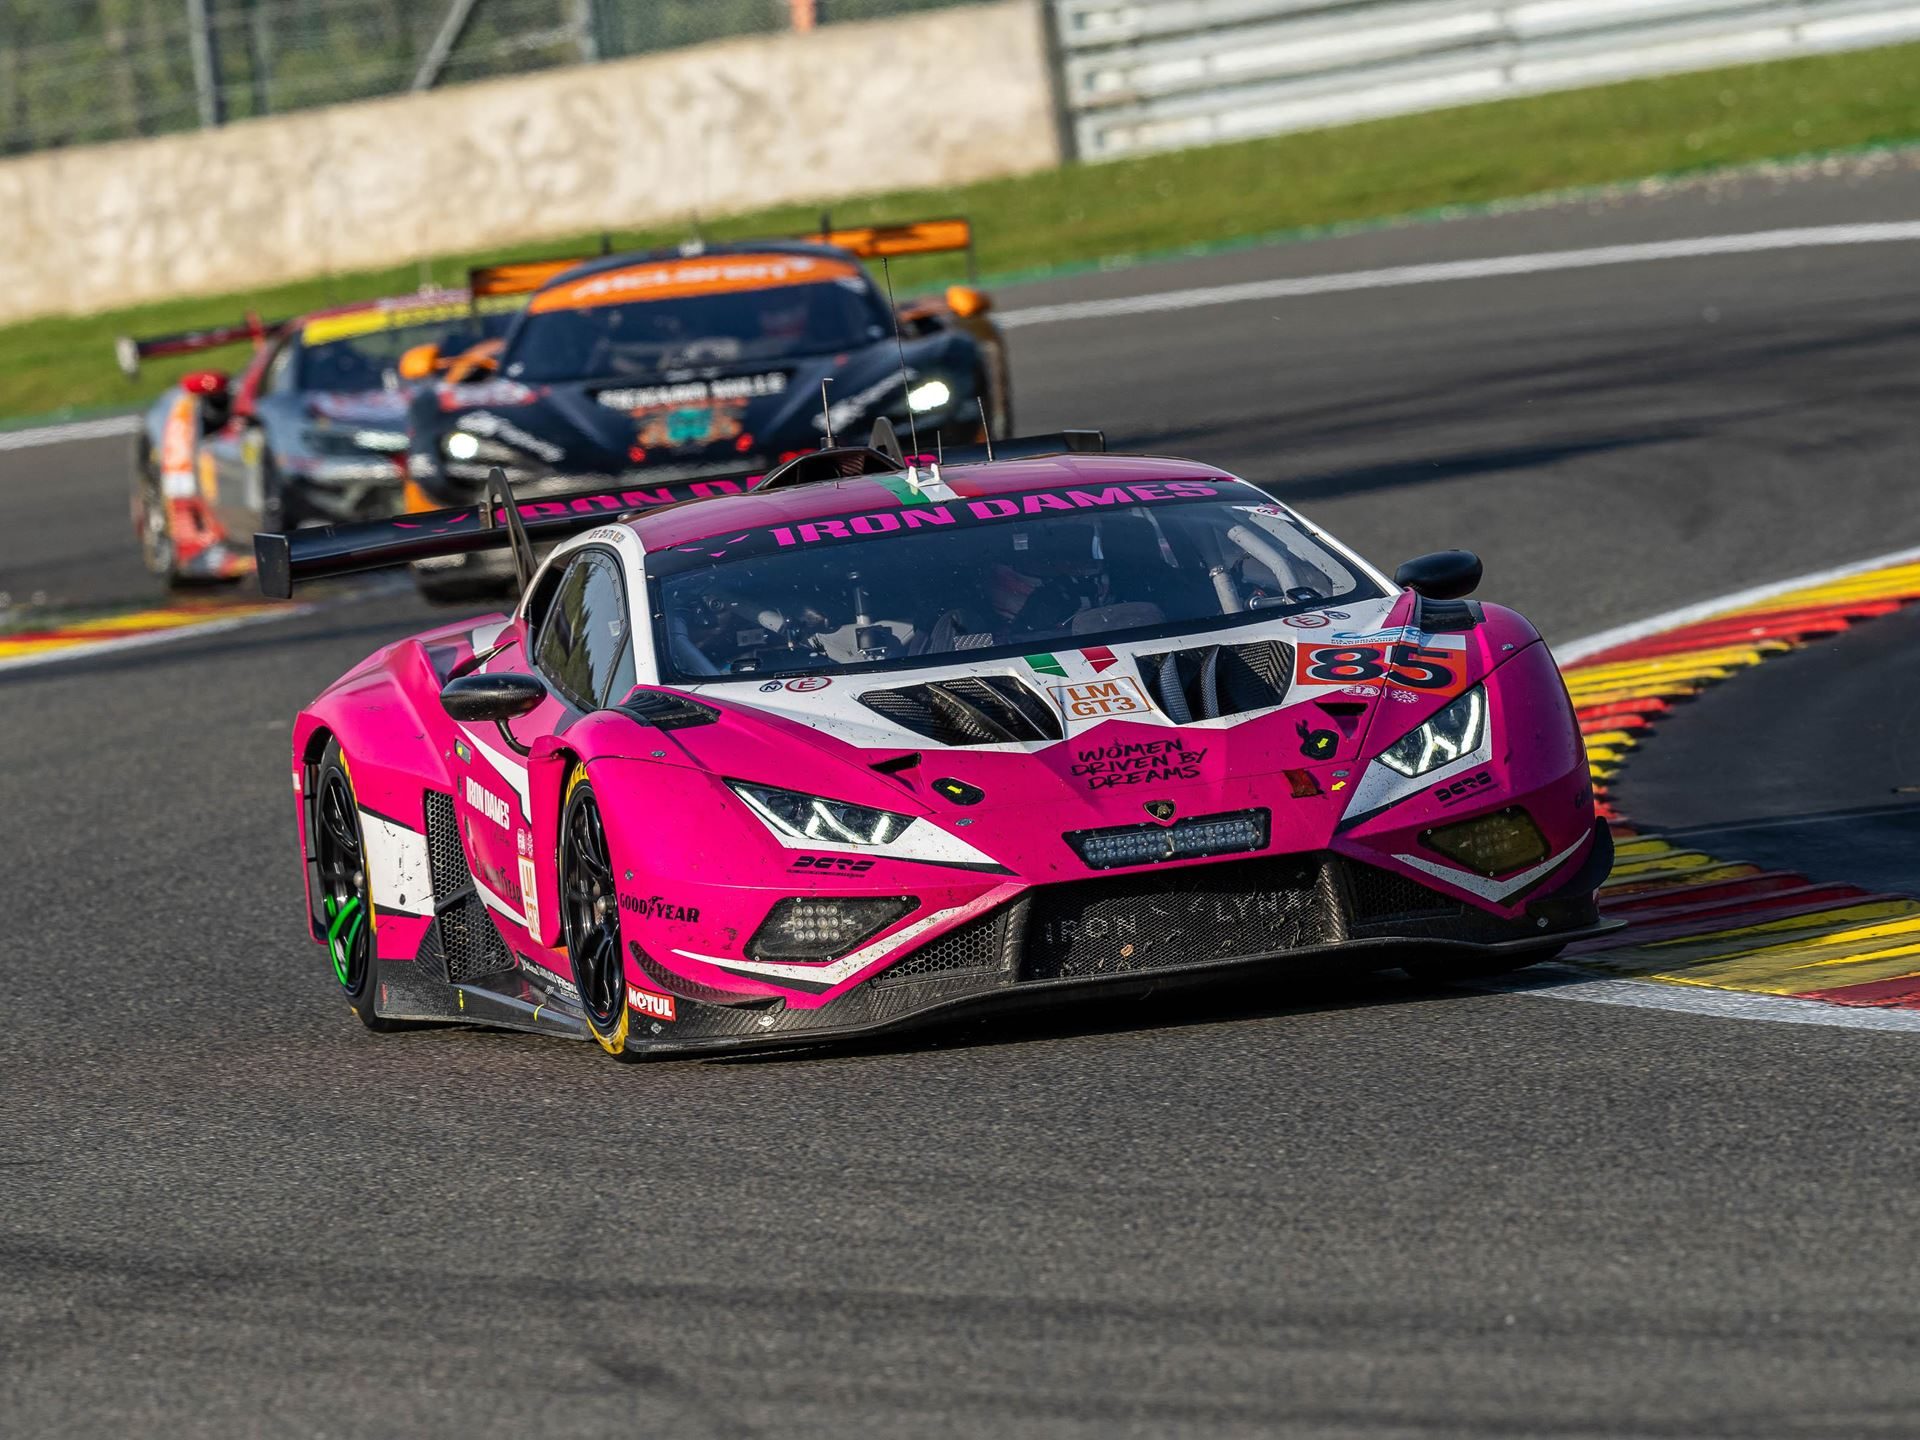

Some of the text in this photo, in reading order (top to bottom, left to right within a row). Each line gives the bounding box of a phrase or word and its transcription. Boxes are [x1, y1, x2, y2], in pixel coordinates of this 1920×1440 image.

[768, 480, 1219, 547] IRON DAMES
[1306, 646, 1456, 690] 85
[1067, 682, 1121, 701] LM
[1071, 696, 1137, 717] GT3
[1071, 748, 1208, 777] DRIVEN BY
[1078, 738, 1183, 763] WOMEN
[1087, 765, 1201, 790] DREAMS
[466, 776, 510, 831] IRON DAMES
[619, 892, 701, 923] GOODYEAR
[1215, 888, 1302, 923] LYNX
[628, 987, 674, 1018] MOTUL
